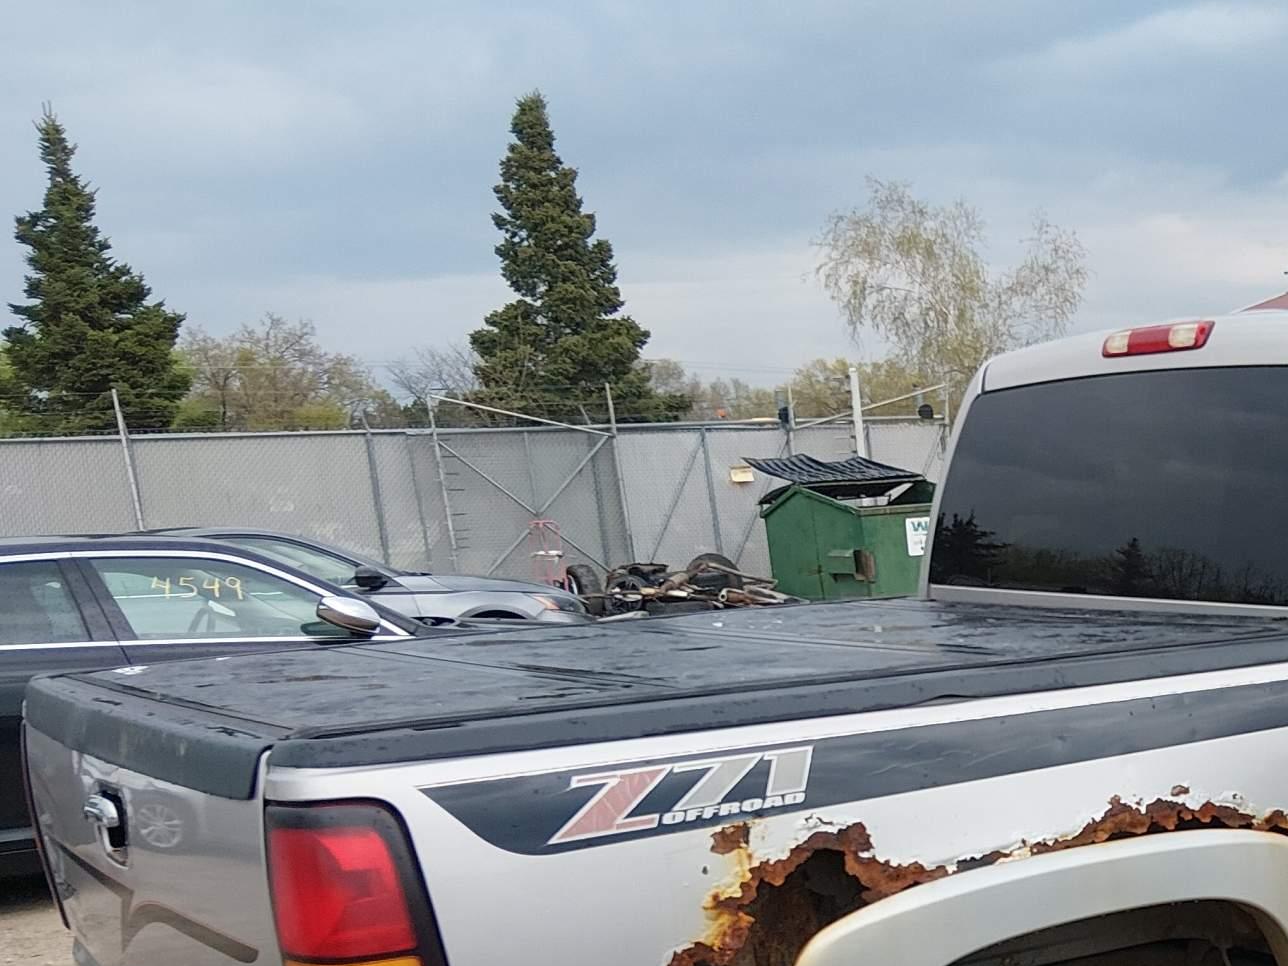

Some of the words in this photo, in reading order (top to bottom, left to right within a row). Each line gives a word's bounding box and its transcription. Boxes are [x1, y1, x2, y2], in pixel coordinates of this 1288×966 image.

[151, 576, 244, 600] 4549
[545, 746, 814, 845] Z71
[661, 792, 806, 825] OFFROAD
